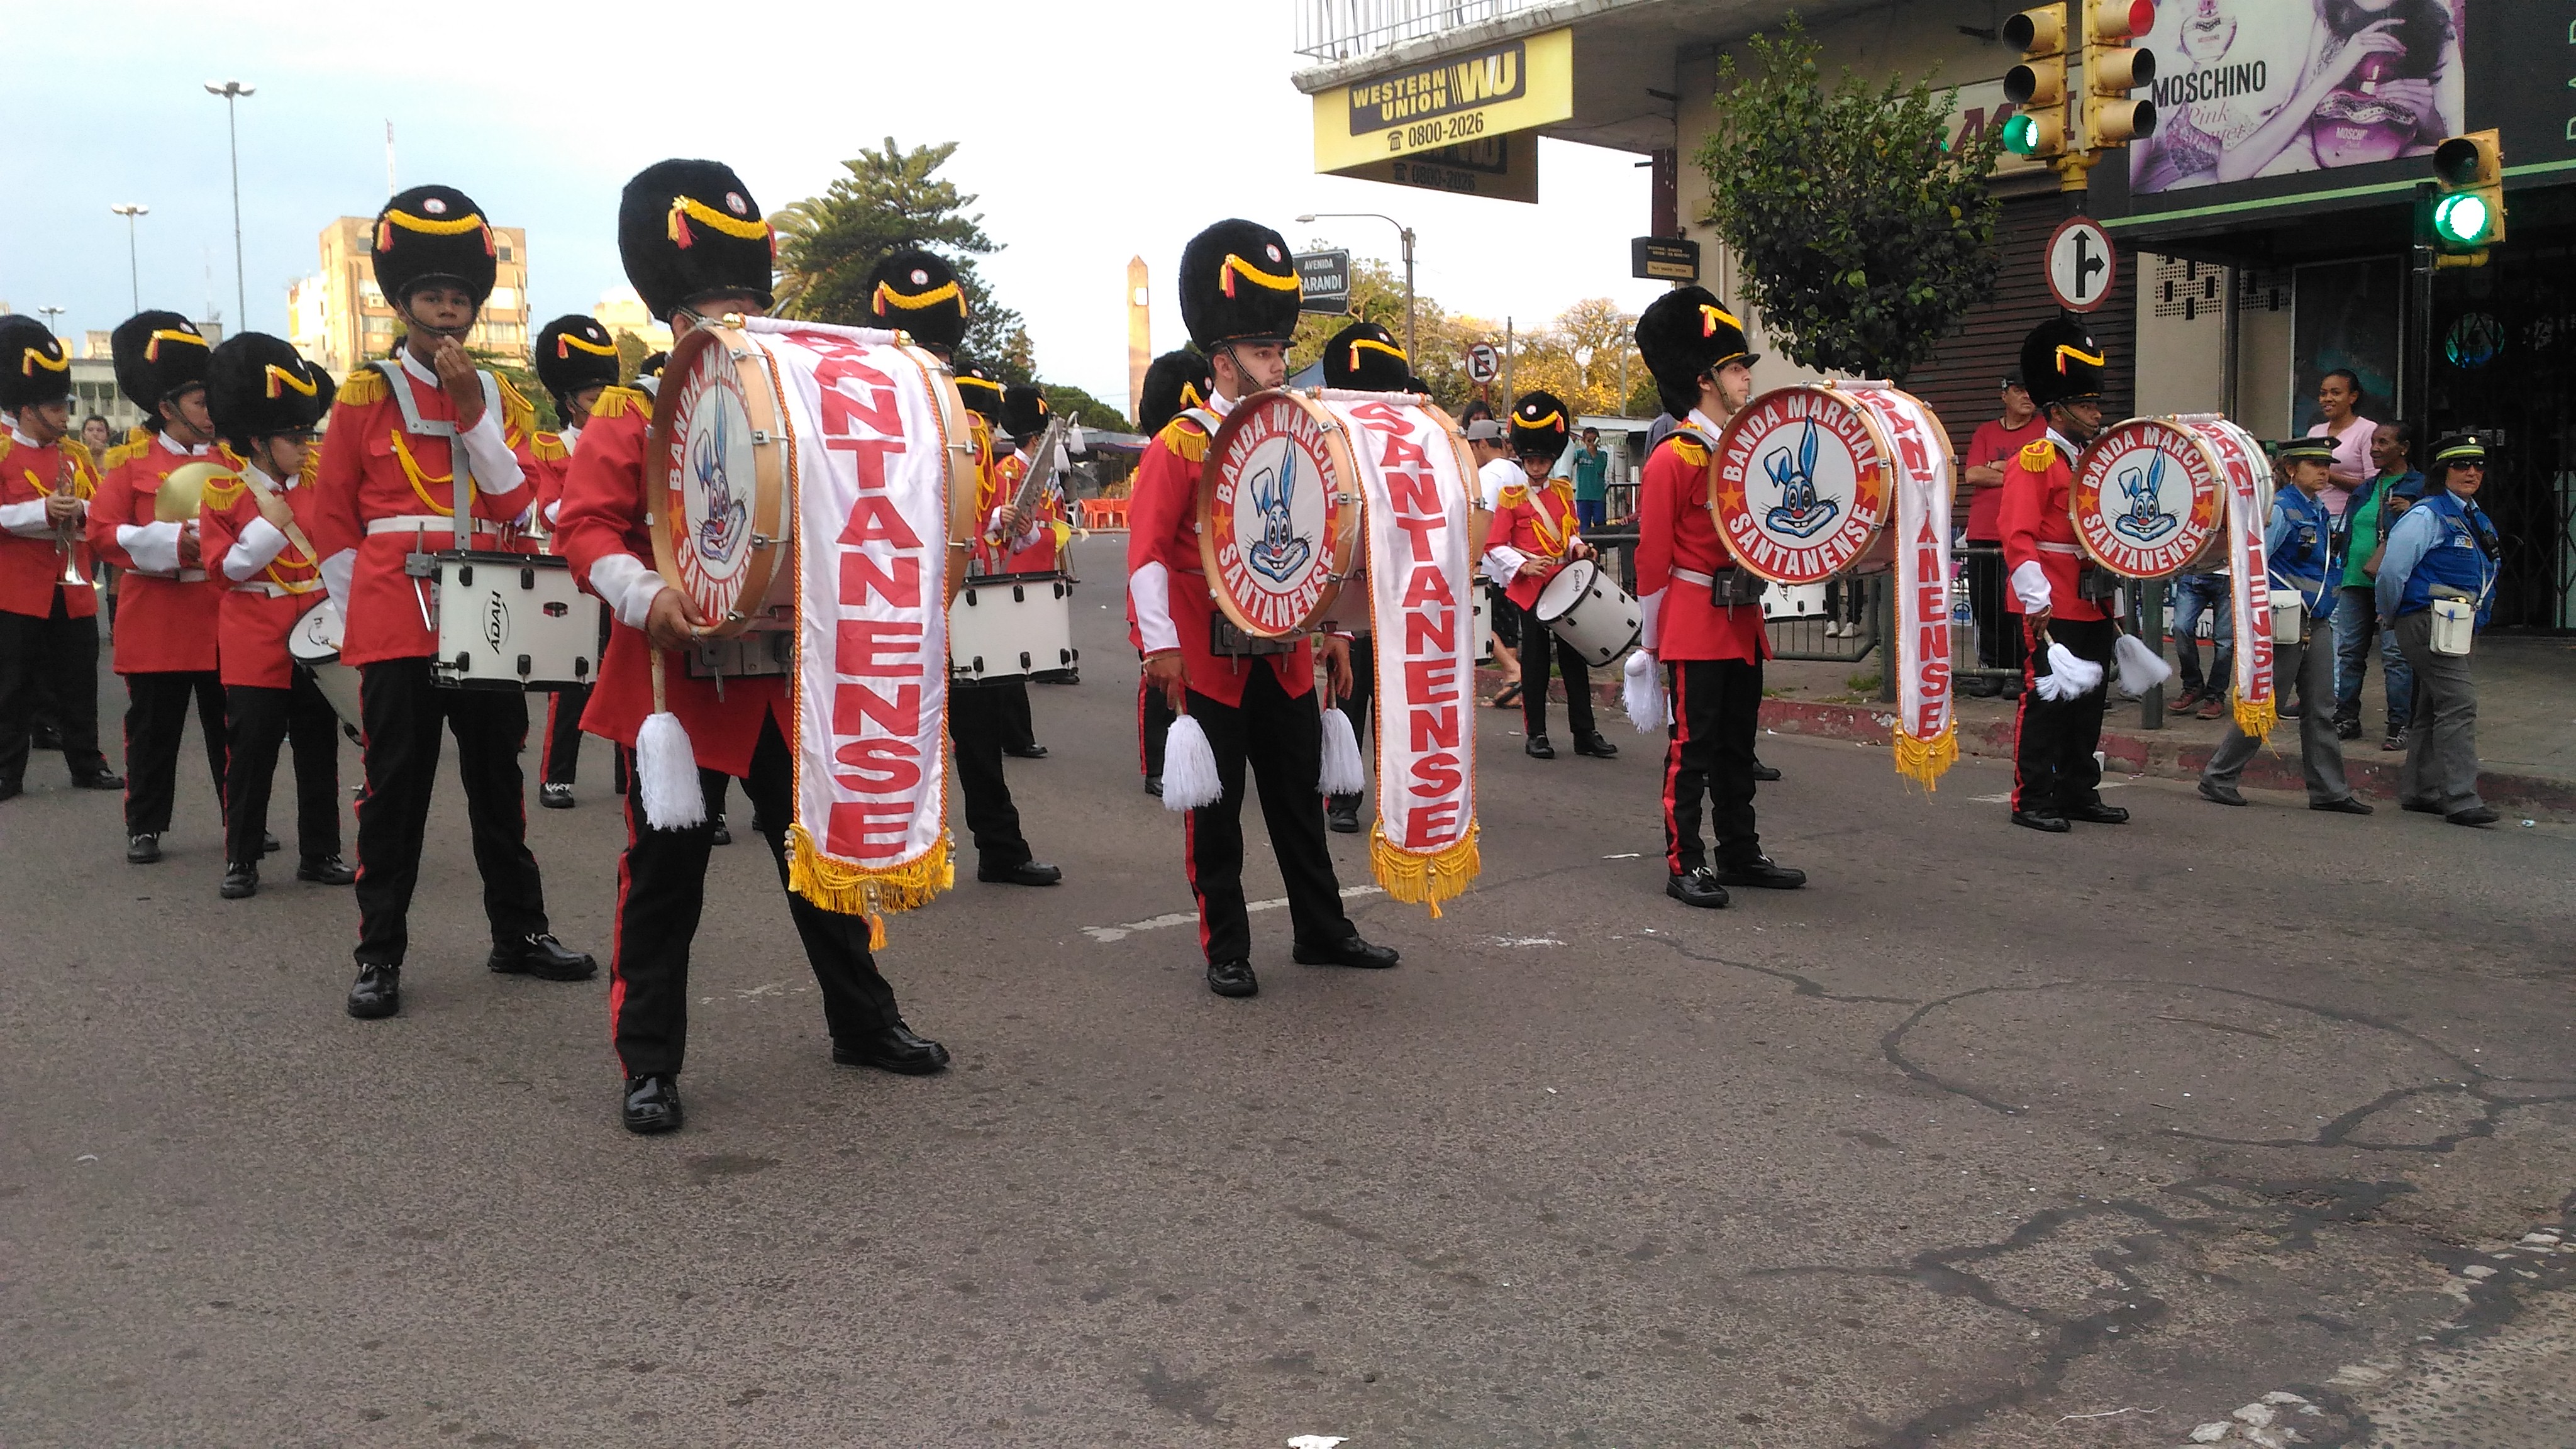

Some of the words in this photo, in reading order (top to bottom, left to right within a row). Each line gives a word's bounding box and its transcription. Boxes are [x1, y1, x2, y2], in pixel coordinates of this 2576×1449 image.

[1353, 68, 1446, 108] WESTERN
[1381, 89, 1446, 121] UNION
[2151, 60, 2267, 109] MOSCHINO
[1408, 112, 1484, 147] 0800-2026
[2335, 126, 2368, 140] MOSCH
[1304, 258, 1334, 271] AVENIDA
[669, 366, 701, 491] BANDA
[702, 341, 749, 408] MARC
[1722, 404, 1781, 482] BANDA
[1787, 394, 1879, 473] MARCIAL
[1216, 411, 1267, 504] BANDA
[1273, 403, 1338, 508] MARCIAL
[2082, 430, 2136, 489] BANDA
[2143, 426, 2213, 497] MARCIAL
[1729, 504, 1877, 576] SANTANENSE
[2083, 513, 2206, 571] SANTANENSE
[489, 591, 501, 655] ADAH
[1350, 402, 1462, 848] SANTANENSE
